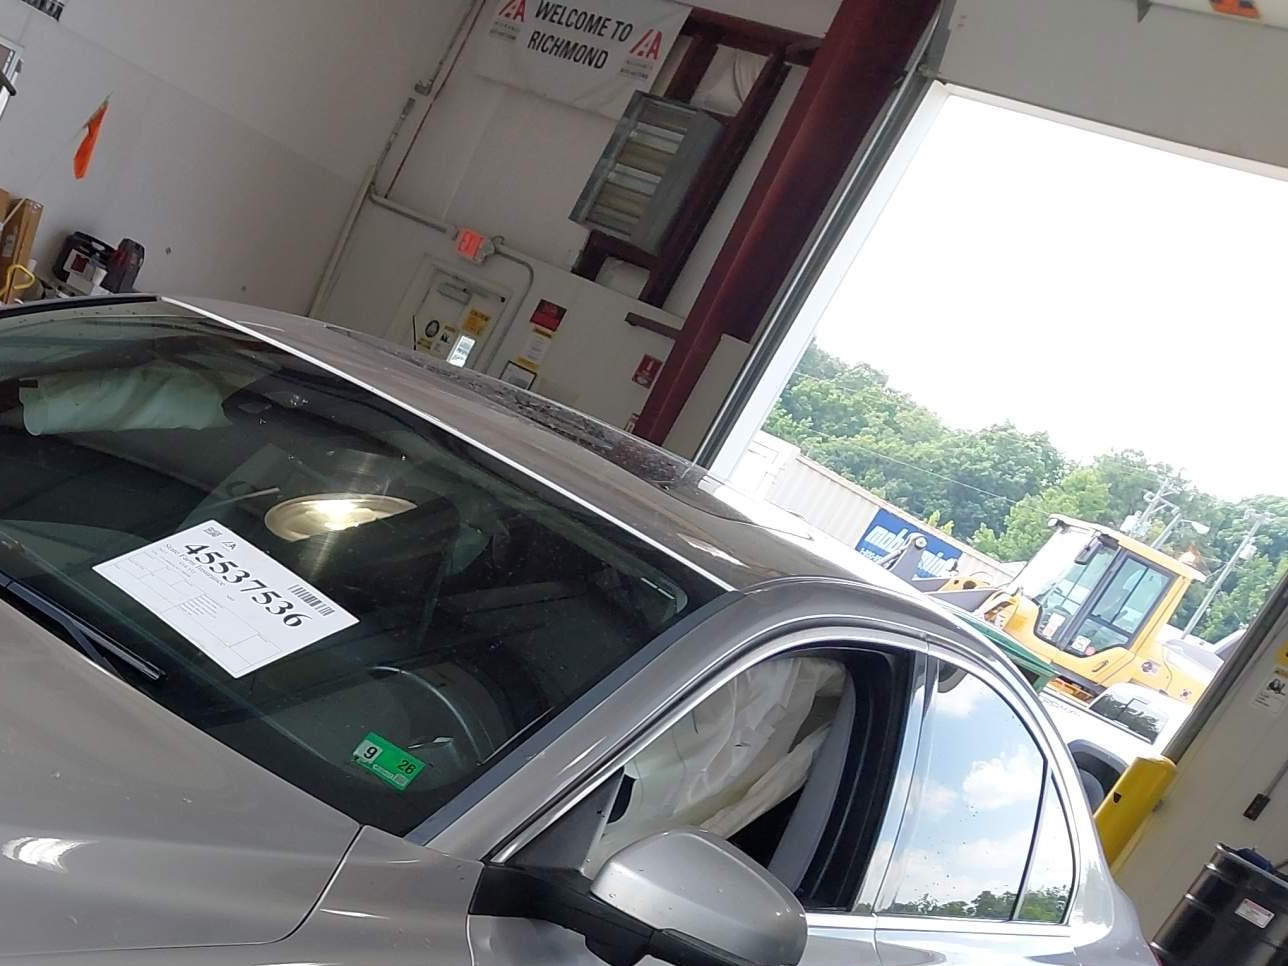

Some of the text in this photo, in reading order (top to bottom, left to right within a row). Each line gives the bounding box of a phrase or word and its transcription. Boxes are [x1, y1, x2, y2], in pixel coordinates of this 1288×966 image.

[534, 0, 611, 37] WELCOME
[611, 20, 633, 42] TO
[527, 31, 609, 69] RICHMOND
[183, 544, 312, 627] 45537536
[363, 746, 378, 760] 9
